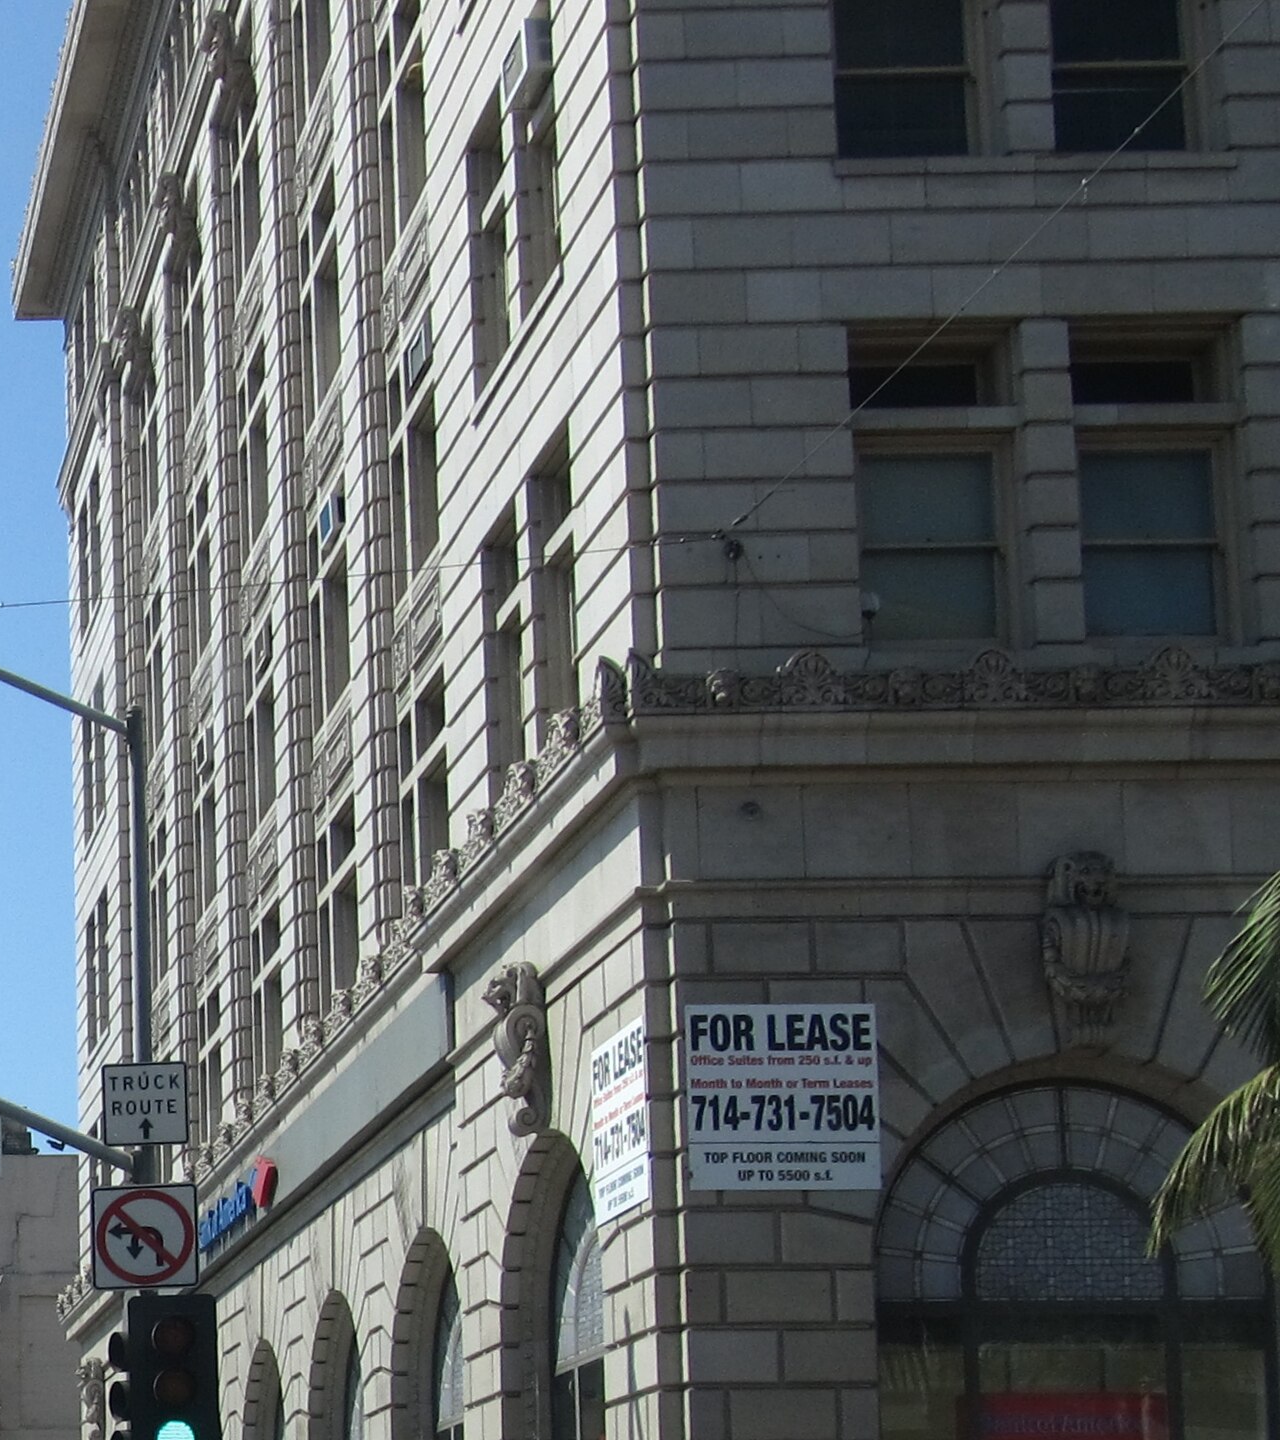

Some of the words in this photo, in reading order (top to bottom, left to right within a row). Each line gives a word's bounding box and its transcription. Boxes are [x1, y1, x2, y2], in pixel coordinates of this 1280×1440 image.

[690, 1013, 755, 1052] FOR
[766, 1013, 873, 1052] LEASE
[592, 1050, 611, 1095] FOR
[613, 1025, 643, 1081] LEASE
[690, 1055, 725, 1066] Office
[728, 1055, 764, 1066] Suites
[767, 1055, 795, 1066] from
[798, 1055, 821, 1066] 250
[844, 1055, 855, 1066] &
[858, 1056, 873, 1068] up
[109, 1073, 181, 1092] TRUCK
[690, 1078, 728, 1089] Month
[731, 1079, 743, 1089] to
[745, 1078, 783, 1089] Month
[786, 1080, 799, 1089] or
[802, 1078, 830, 1089] Term
[833, 1078, 873, 1089] Leases
[112, 1099, 177, 1116] ROUTE
[691, 1093, 876, 1132] 714-731-7504
[703, 1152, 729, 1164] TOP
[732, 1152, 773, 1164] FLOOR
[776, 1151, 828, 1163] COMING
[831, 1151, 866, 1163] SOON
[738, 1169, 755, 1182] UP
[757, 1169, 775, 1182] TO
[778, 1169, 811, 1182] 5500
